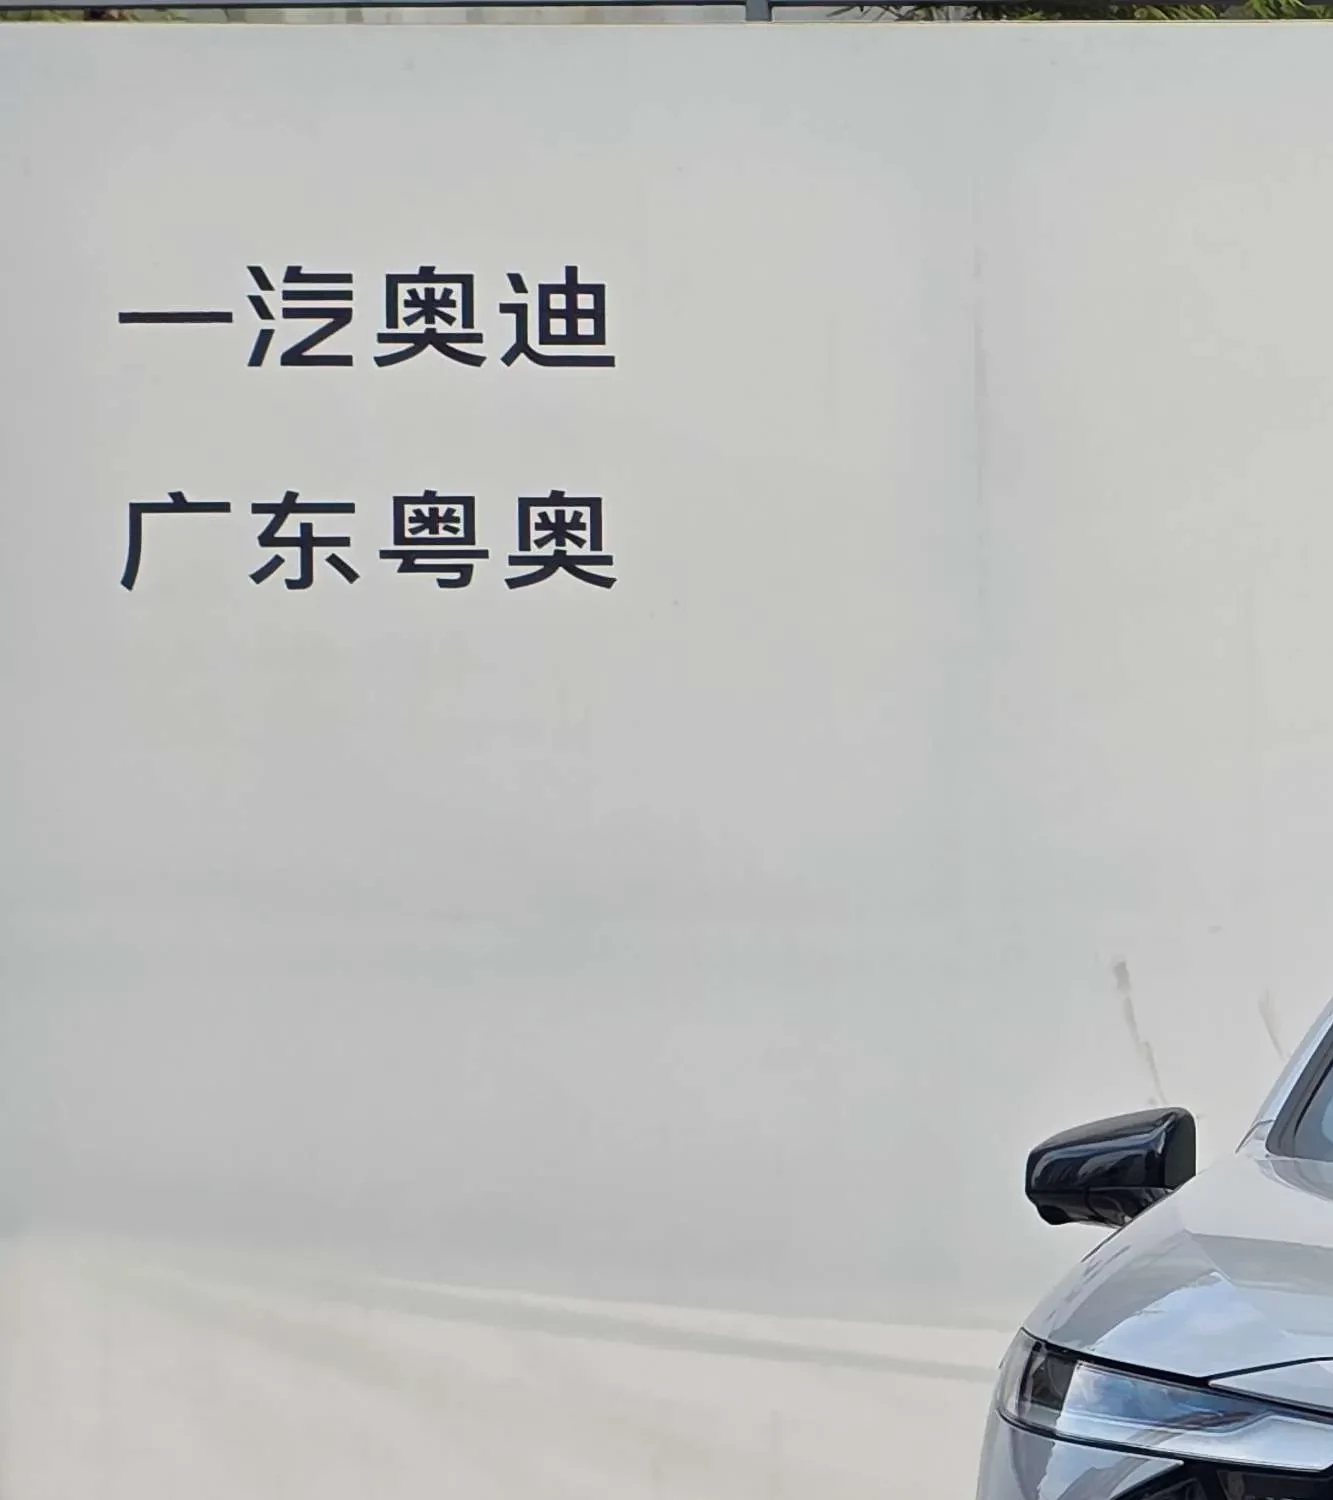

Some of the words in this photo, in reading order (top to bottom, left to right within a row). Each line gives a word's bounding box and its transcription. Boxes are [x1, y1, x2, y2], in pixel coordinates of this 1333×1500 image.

[118, 265, 616, 368] 一汽奥迪
[120, 489, 617, 591] 广东粤奥
